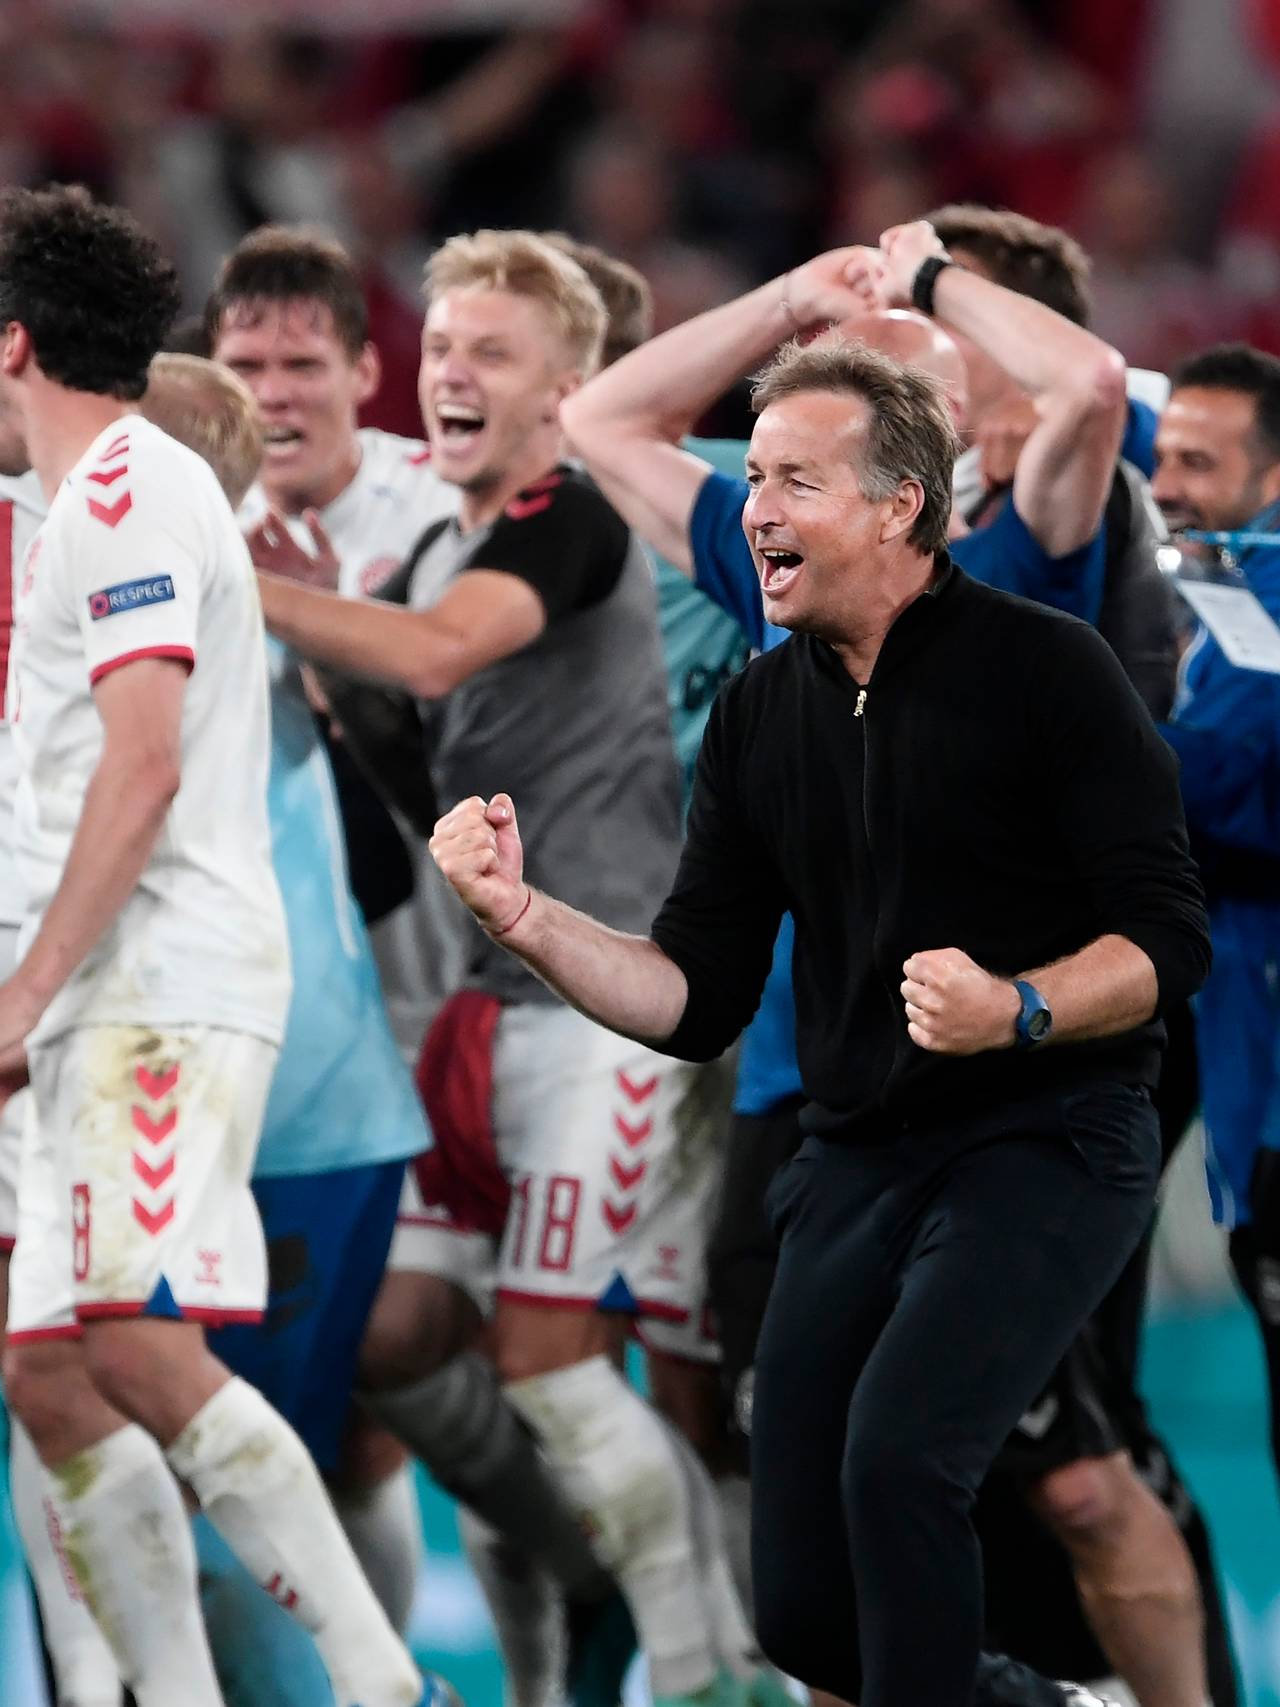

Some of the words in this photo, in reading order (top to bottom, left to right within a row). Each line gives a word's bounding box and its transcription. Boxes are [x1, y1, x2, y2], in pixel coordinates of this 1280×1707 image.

[108, 579, 172, 608] RESPECT
[73, 1183, 90, 1281] 8
[514, 1176, 581, 1271] 18
